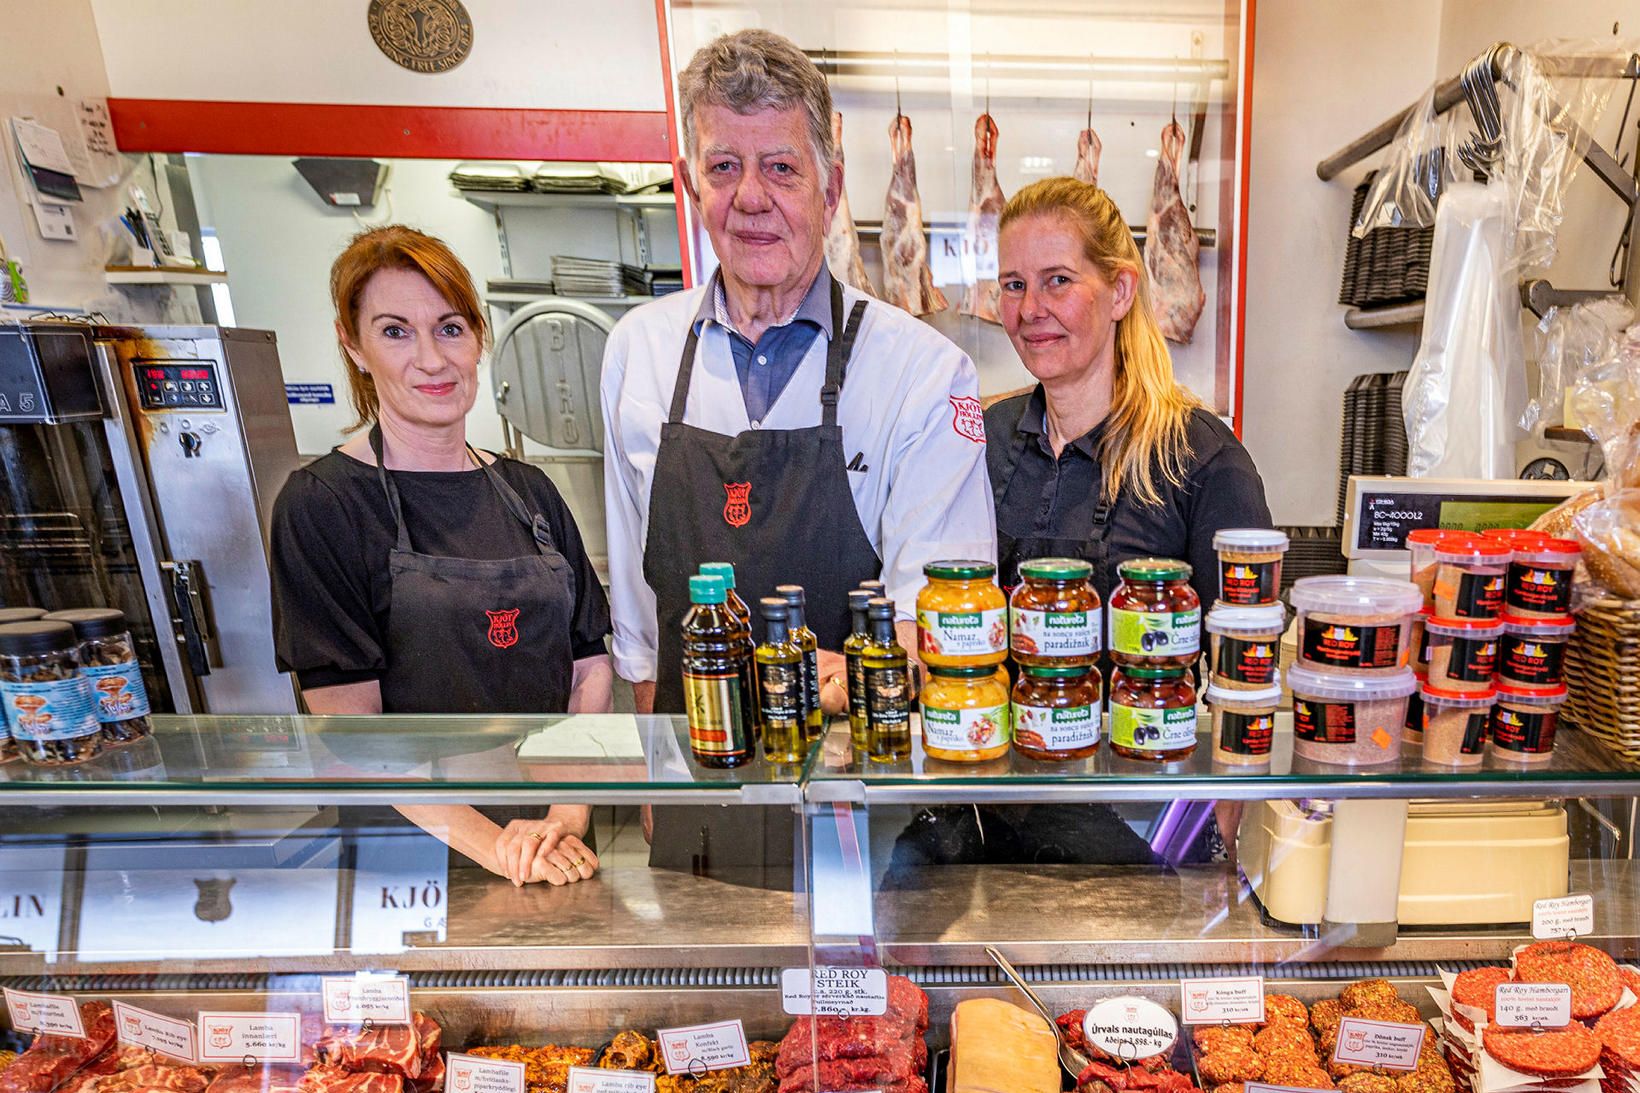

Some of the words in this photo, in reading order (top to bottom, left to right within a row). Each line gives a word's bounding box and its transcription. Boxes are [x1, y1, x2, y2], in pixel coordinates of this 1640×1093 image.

[1373, 510, 1424, 521] BC-4000L2
[1044, 636, 1090, 653] paradižnik
[1052, 730, 1094, 747] paradižnik
[381, 879, 441, 909] KJÖ
[842, 970, 868, 979] ROY
[817, 980, 859, 988] STEIK
[1092, 1023, 1119, 1034] Úrvals
[1122, 1026, 1173, 1040] nautagúllas
[1154, 1039, 1162, 1048] kg
